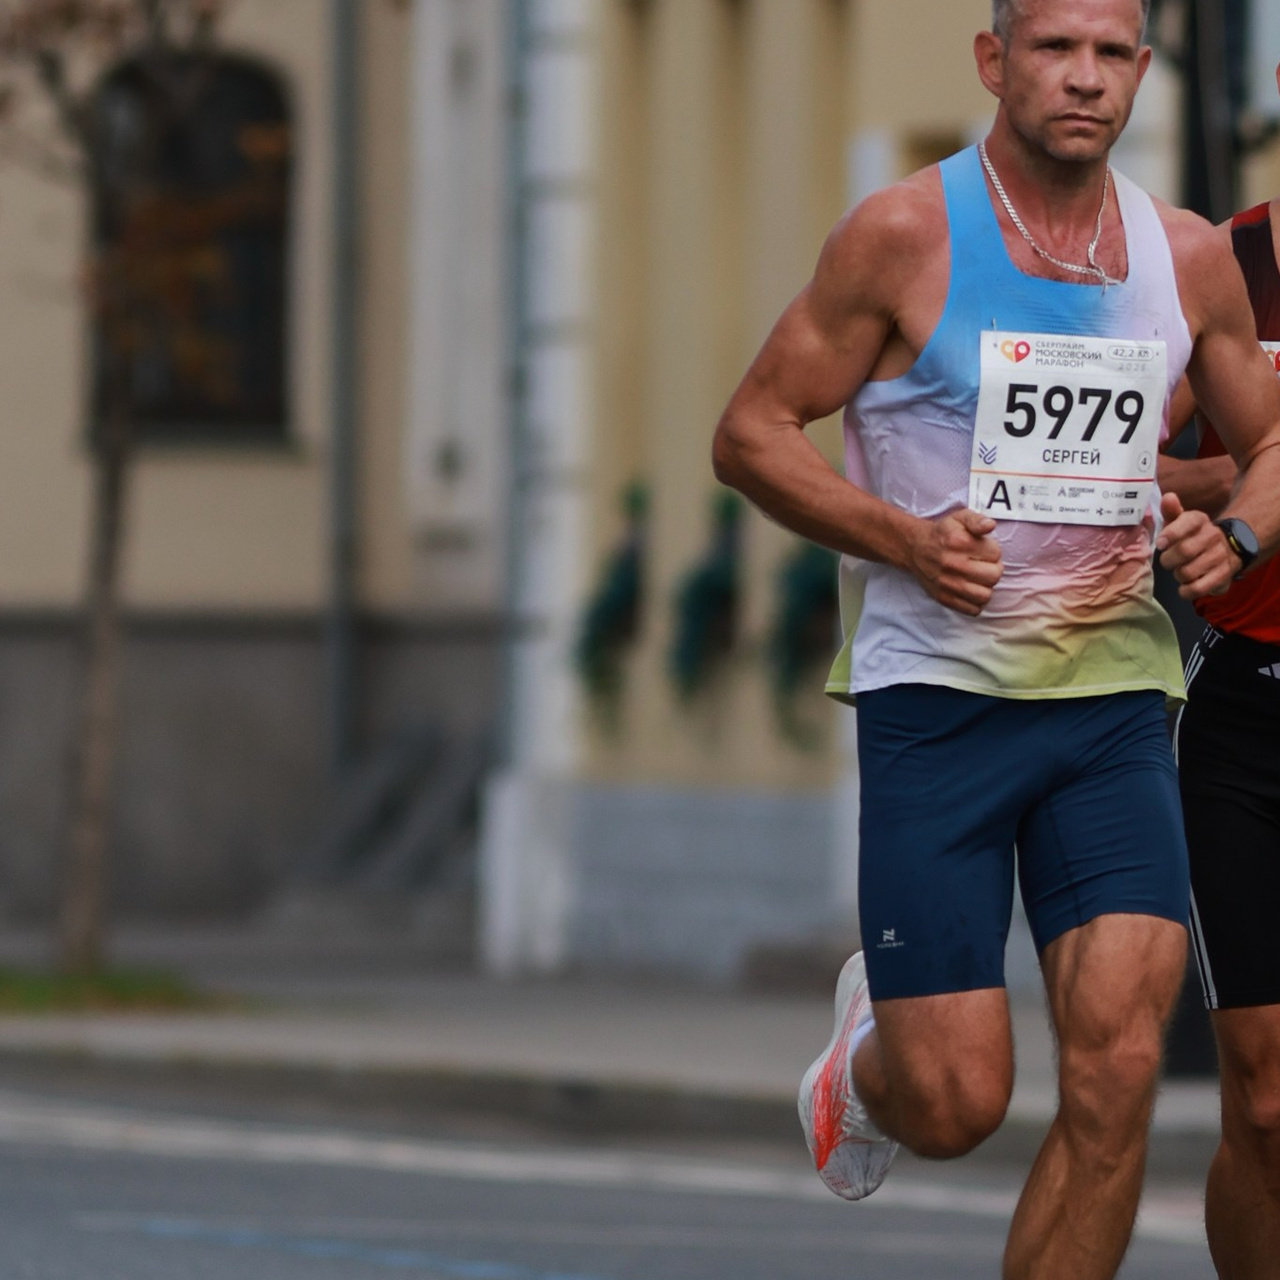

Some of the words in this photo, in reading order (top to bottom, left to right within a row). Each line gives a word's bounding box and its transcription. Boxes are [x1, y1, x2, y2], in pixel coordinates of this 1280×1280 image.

[1035, 349, 1102, 360] МОСКОВСКИЙ
[1035, 358, 1084, 368] МАРАФОН
[1003, 383, 1144, 444] 5979
[1042, 448, 1100, 465] СЕРГЕЙ
[1141, 457, 1147, 466] 4
